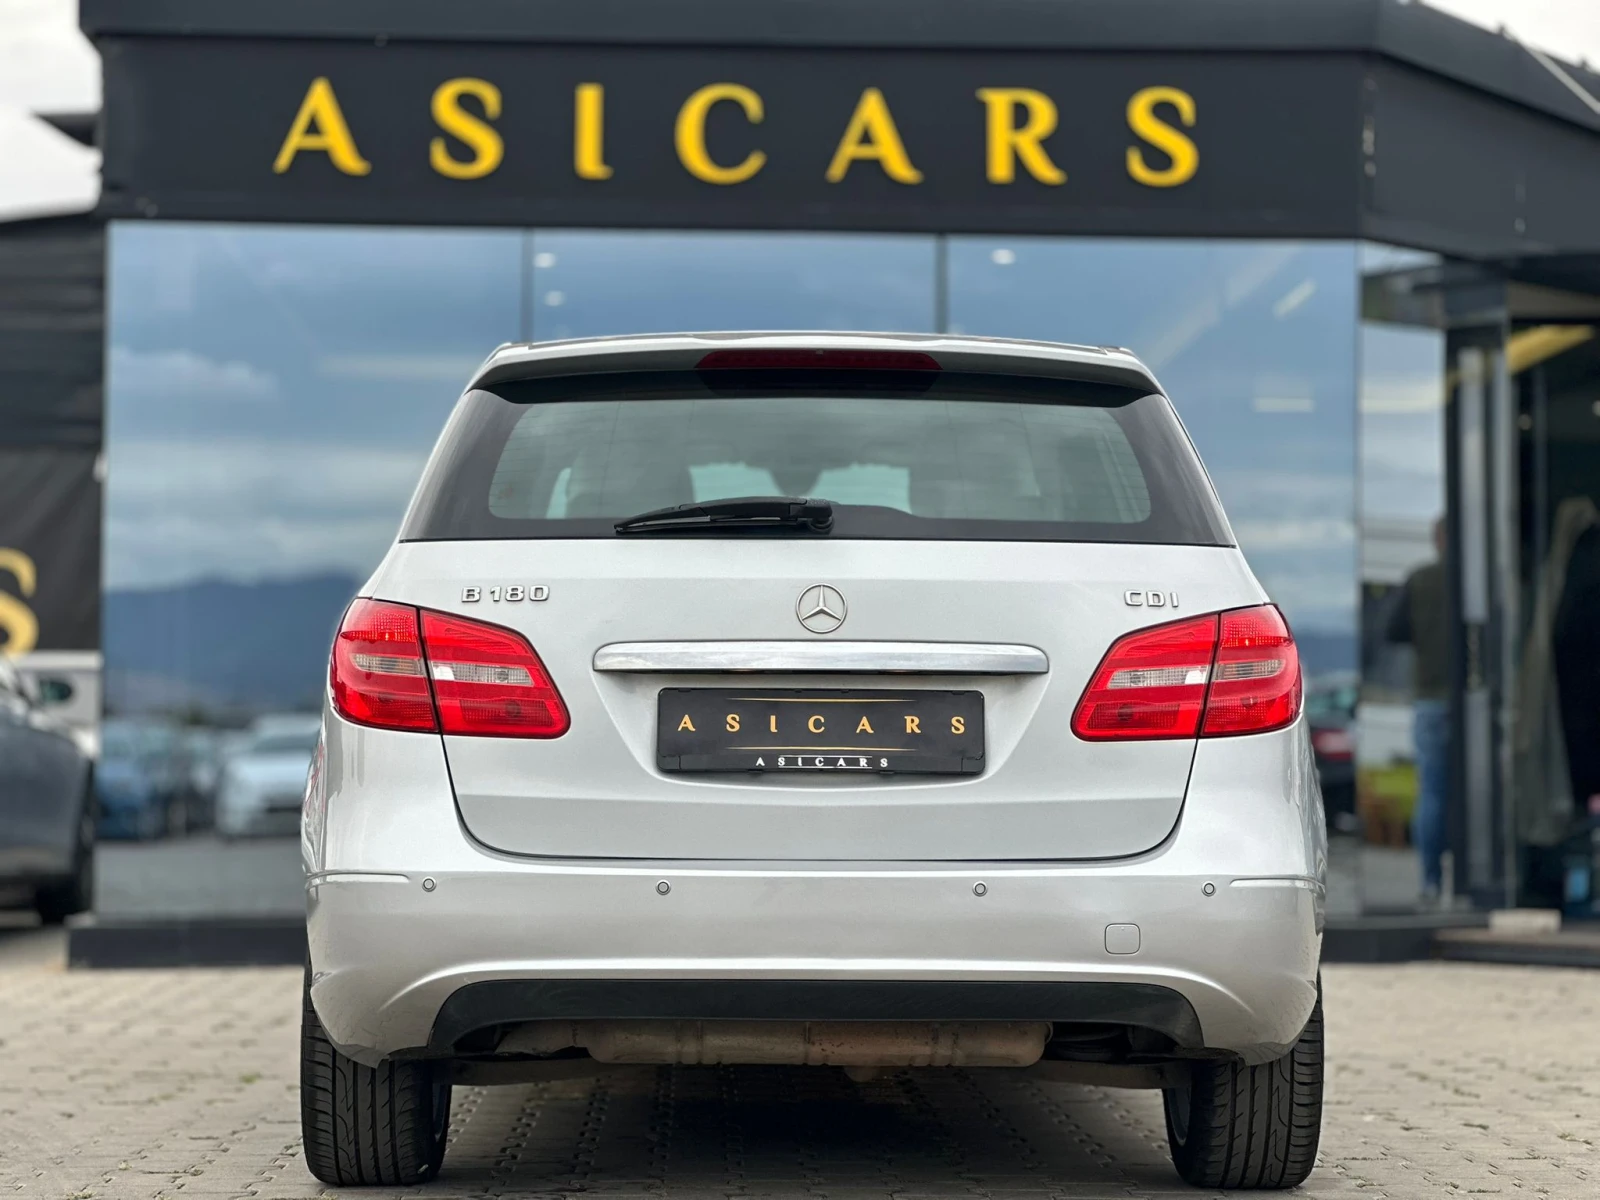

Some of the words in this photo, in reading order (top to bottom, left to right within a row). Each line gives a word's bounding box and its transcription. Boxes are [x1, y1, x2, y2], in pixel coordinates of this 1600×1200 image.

[274, 77, 1200, 187] ASICARS
[461, 586, 481, 603] B
[490, 585, 550, 602] 180
[1124, 589, 1179, 608] CDI
[677, 714, 966, 735] ASICARS
[755, 756, 889, 768] ASICARS
